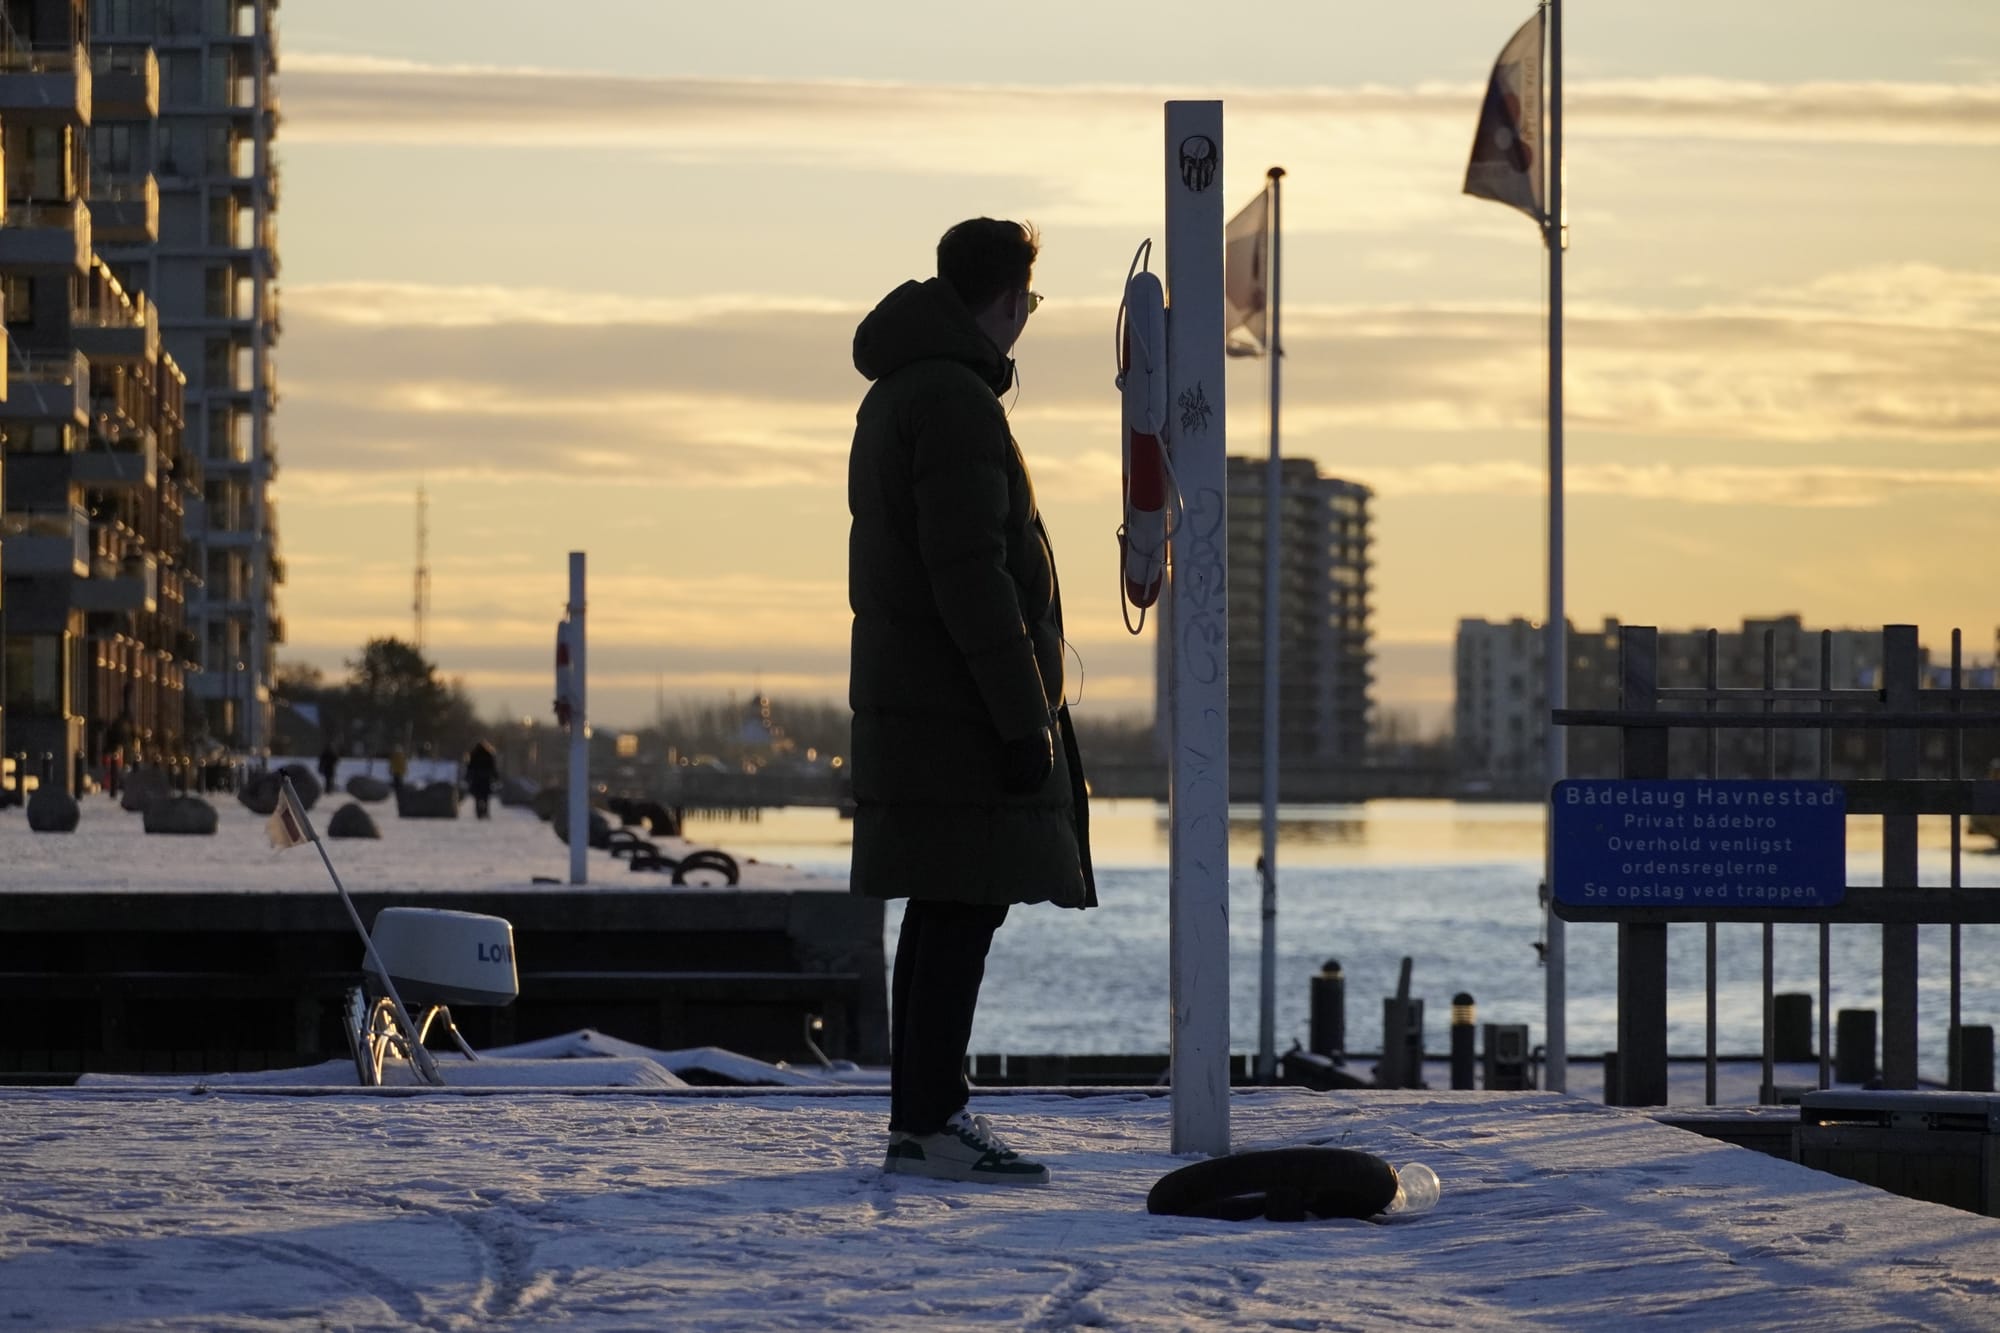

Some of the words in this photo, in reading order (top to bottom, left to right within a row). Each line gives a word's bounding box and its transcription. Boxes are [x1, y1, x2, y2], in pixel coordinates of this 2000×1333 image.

[1565, 785, 1686, 809] Bådelaug
[1697, 786, 1835, 806] Havnestad
[1624, 813, 1685, 828] Privat
[1693, 813, 1777, 828] bådebro
[1608, 836, 1701, 851] Overhold
[1709, 836, 1792, 854] venligst
[1622, 860, 1778, 877] ordensreglerne
[1584, 882, 1609, 897] Se
[1617, 883, 1684, 900] opslag
[1693, 882, 1728, 897] ved
[1737, 885, 1816, 899] trappen
